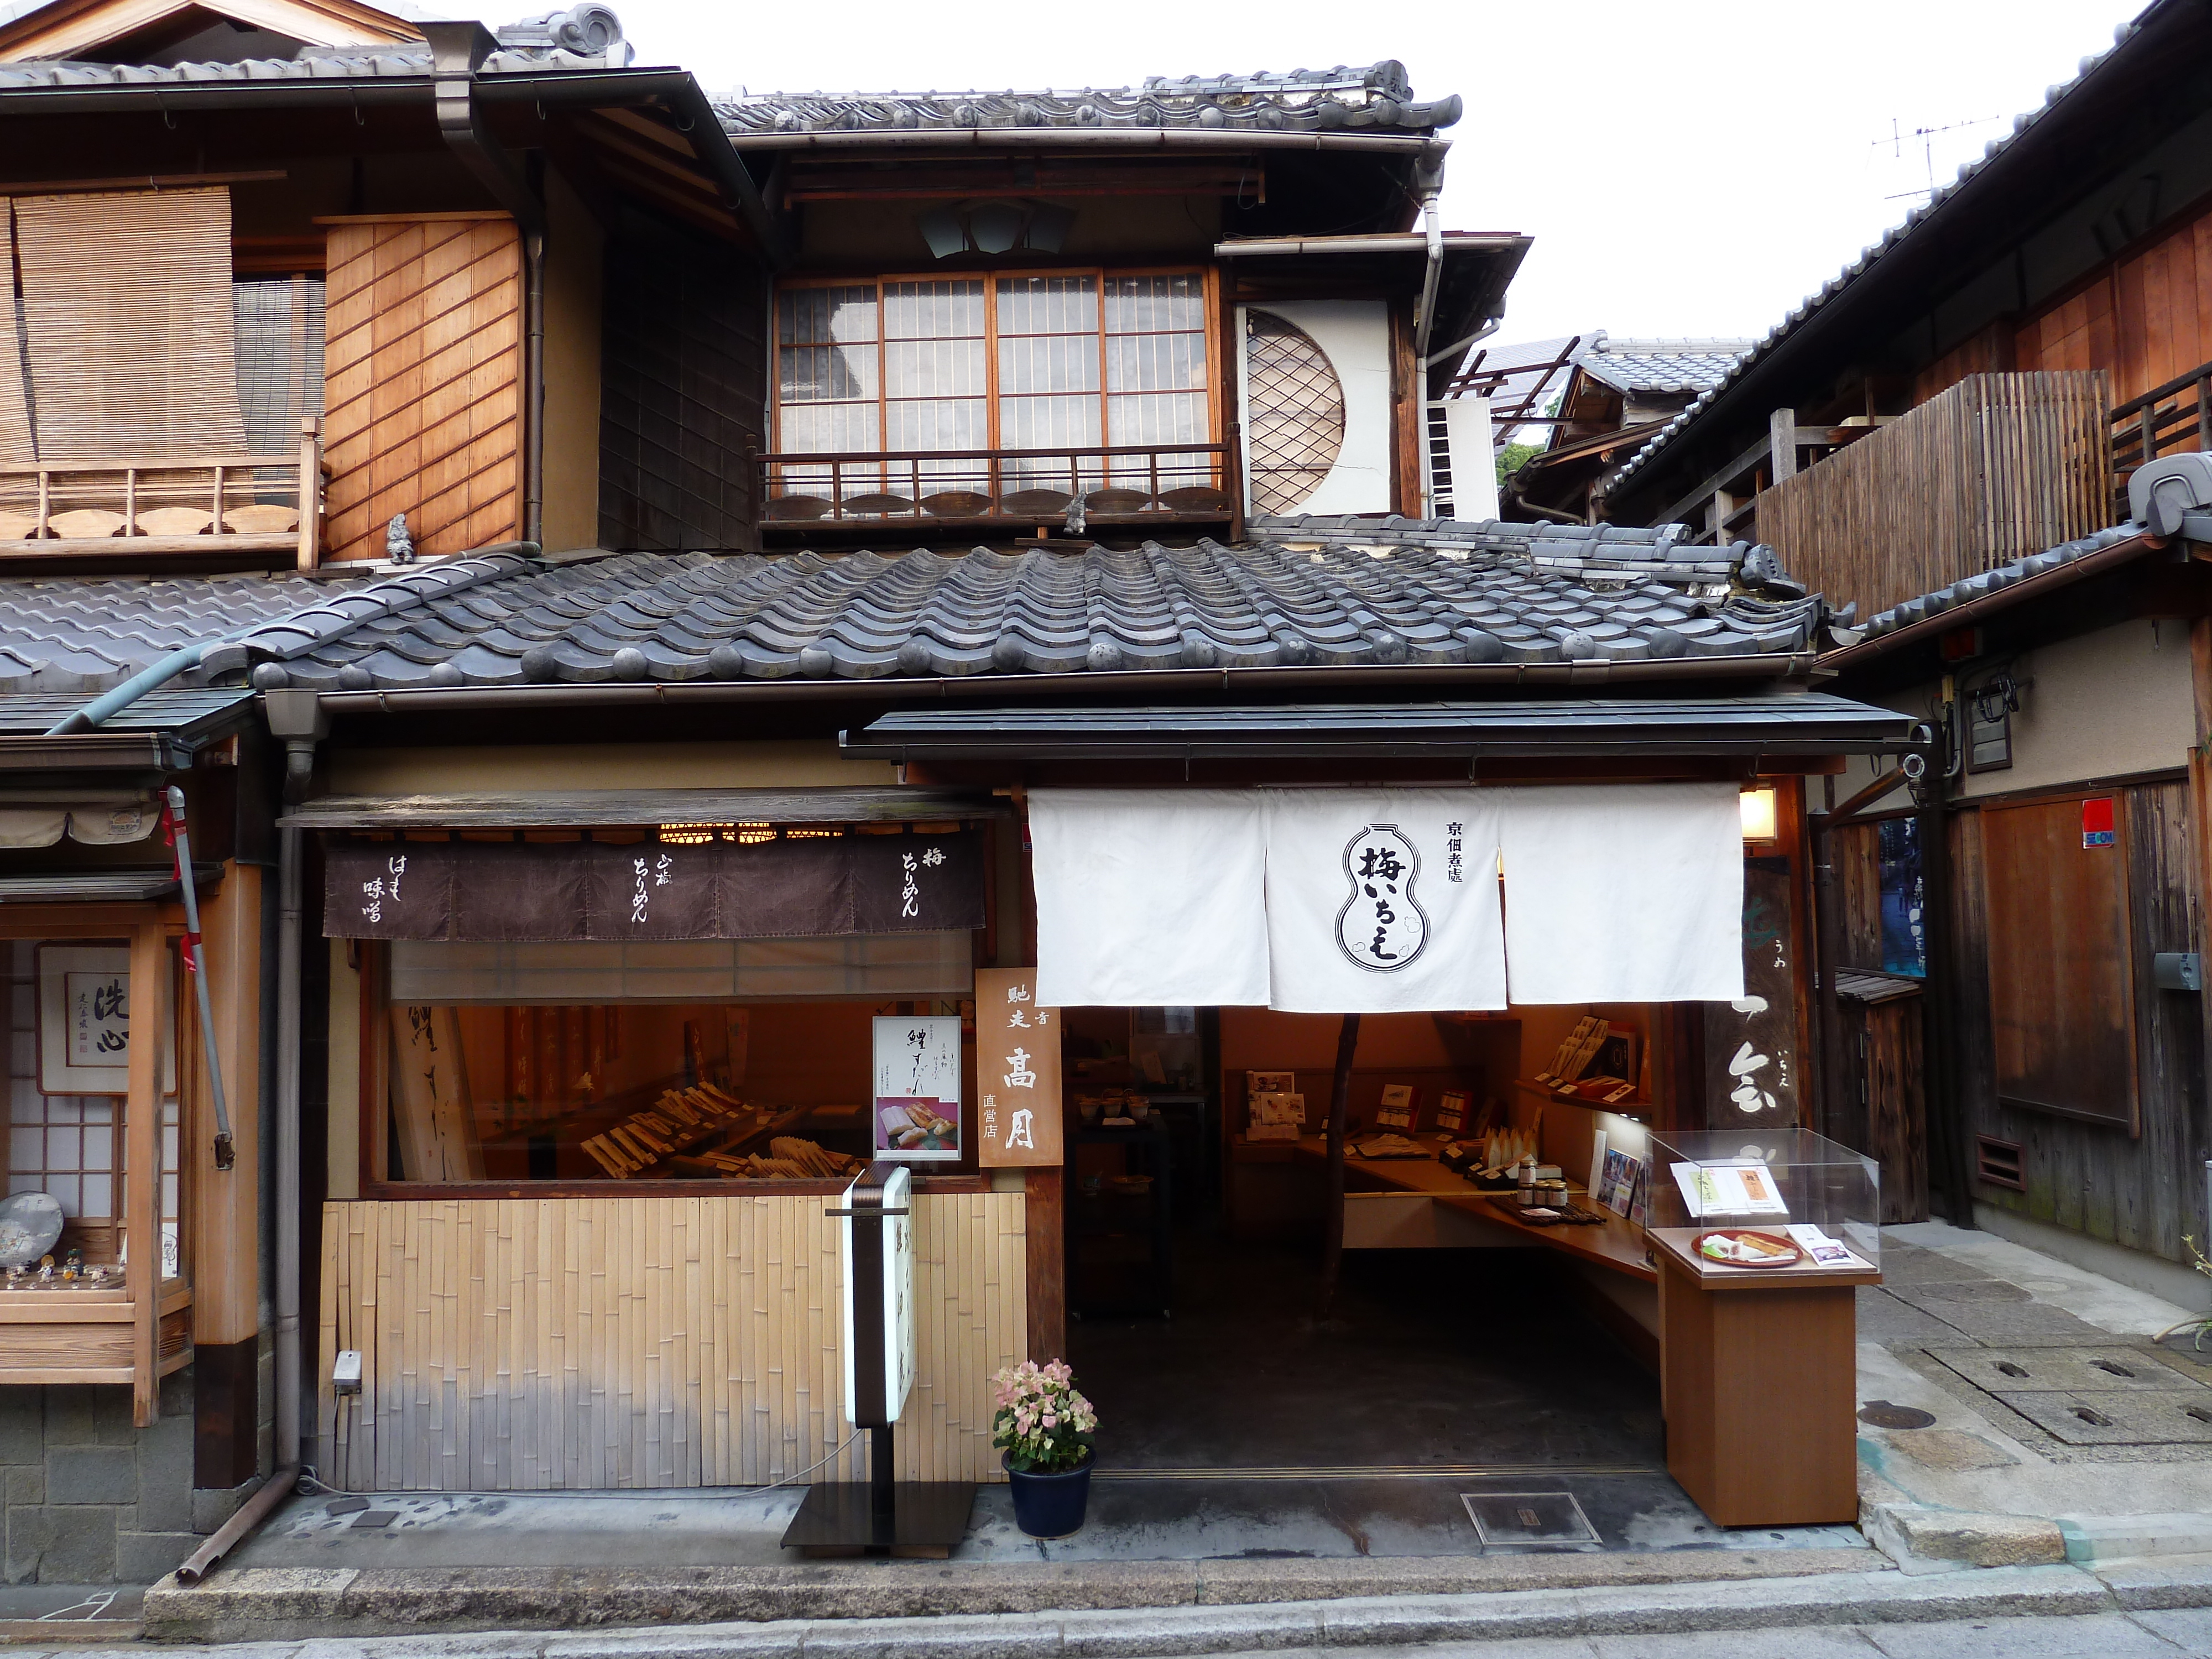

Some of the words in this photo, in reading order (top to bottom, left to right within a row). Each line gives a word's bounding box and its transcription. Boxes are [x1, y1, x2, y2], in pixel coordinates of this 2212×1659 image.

[922, 847, 946, 868] 梅
[1446, 822, 1463, 883] 京佃煮處
[2087, 832, 2112, 844] SECOM
[632, 858, 649, 922] ちりめん
[655, 854, 674, 886] 山椒
[902, 852, 919, 917] ちりめん
[361, 877, 385, 923] 味噌
[983, 1094, 998, 1138] 直営店
